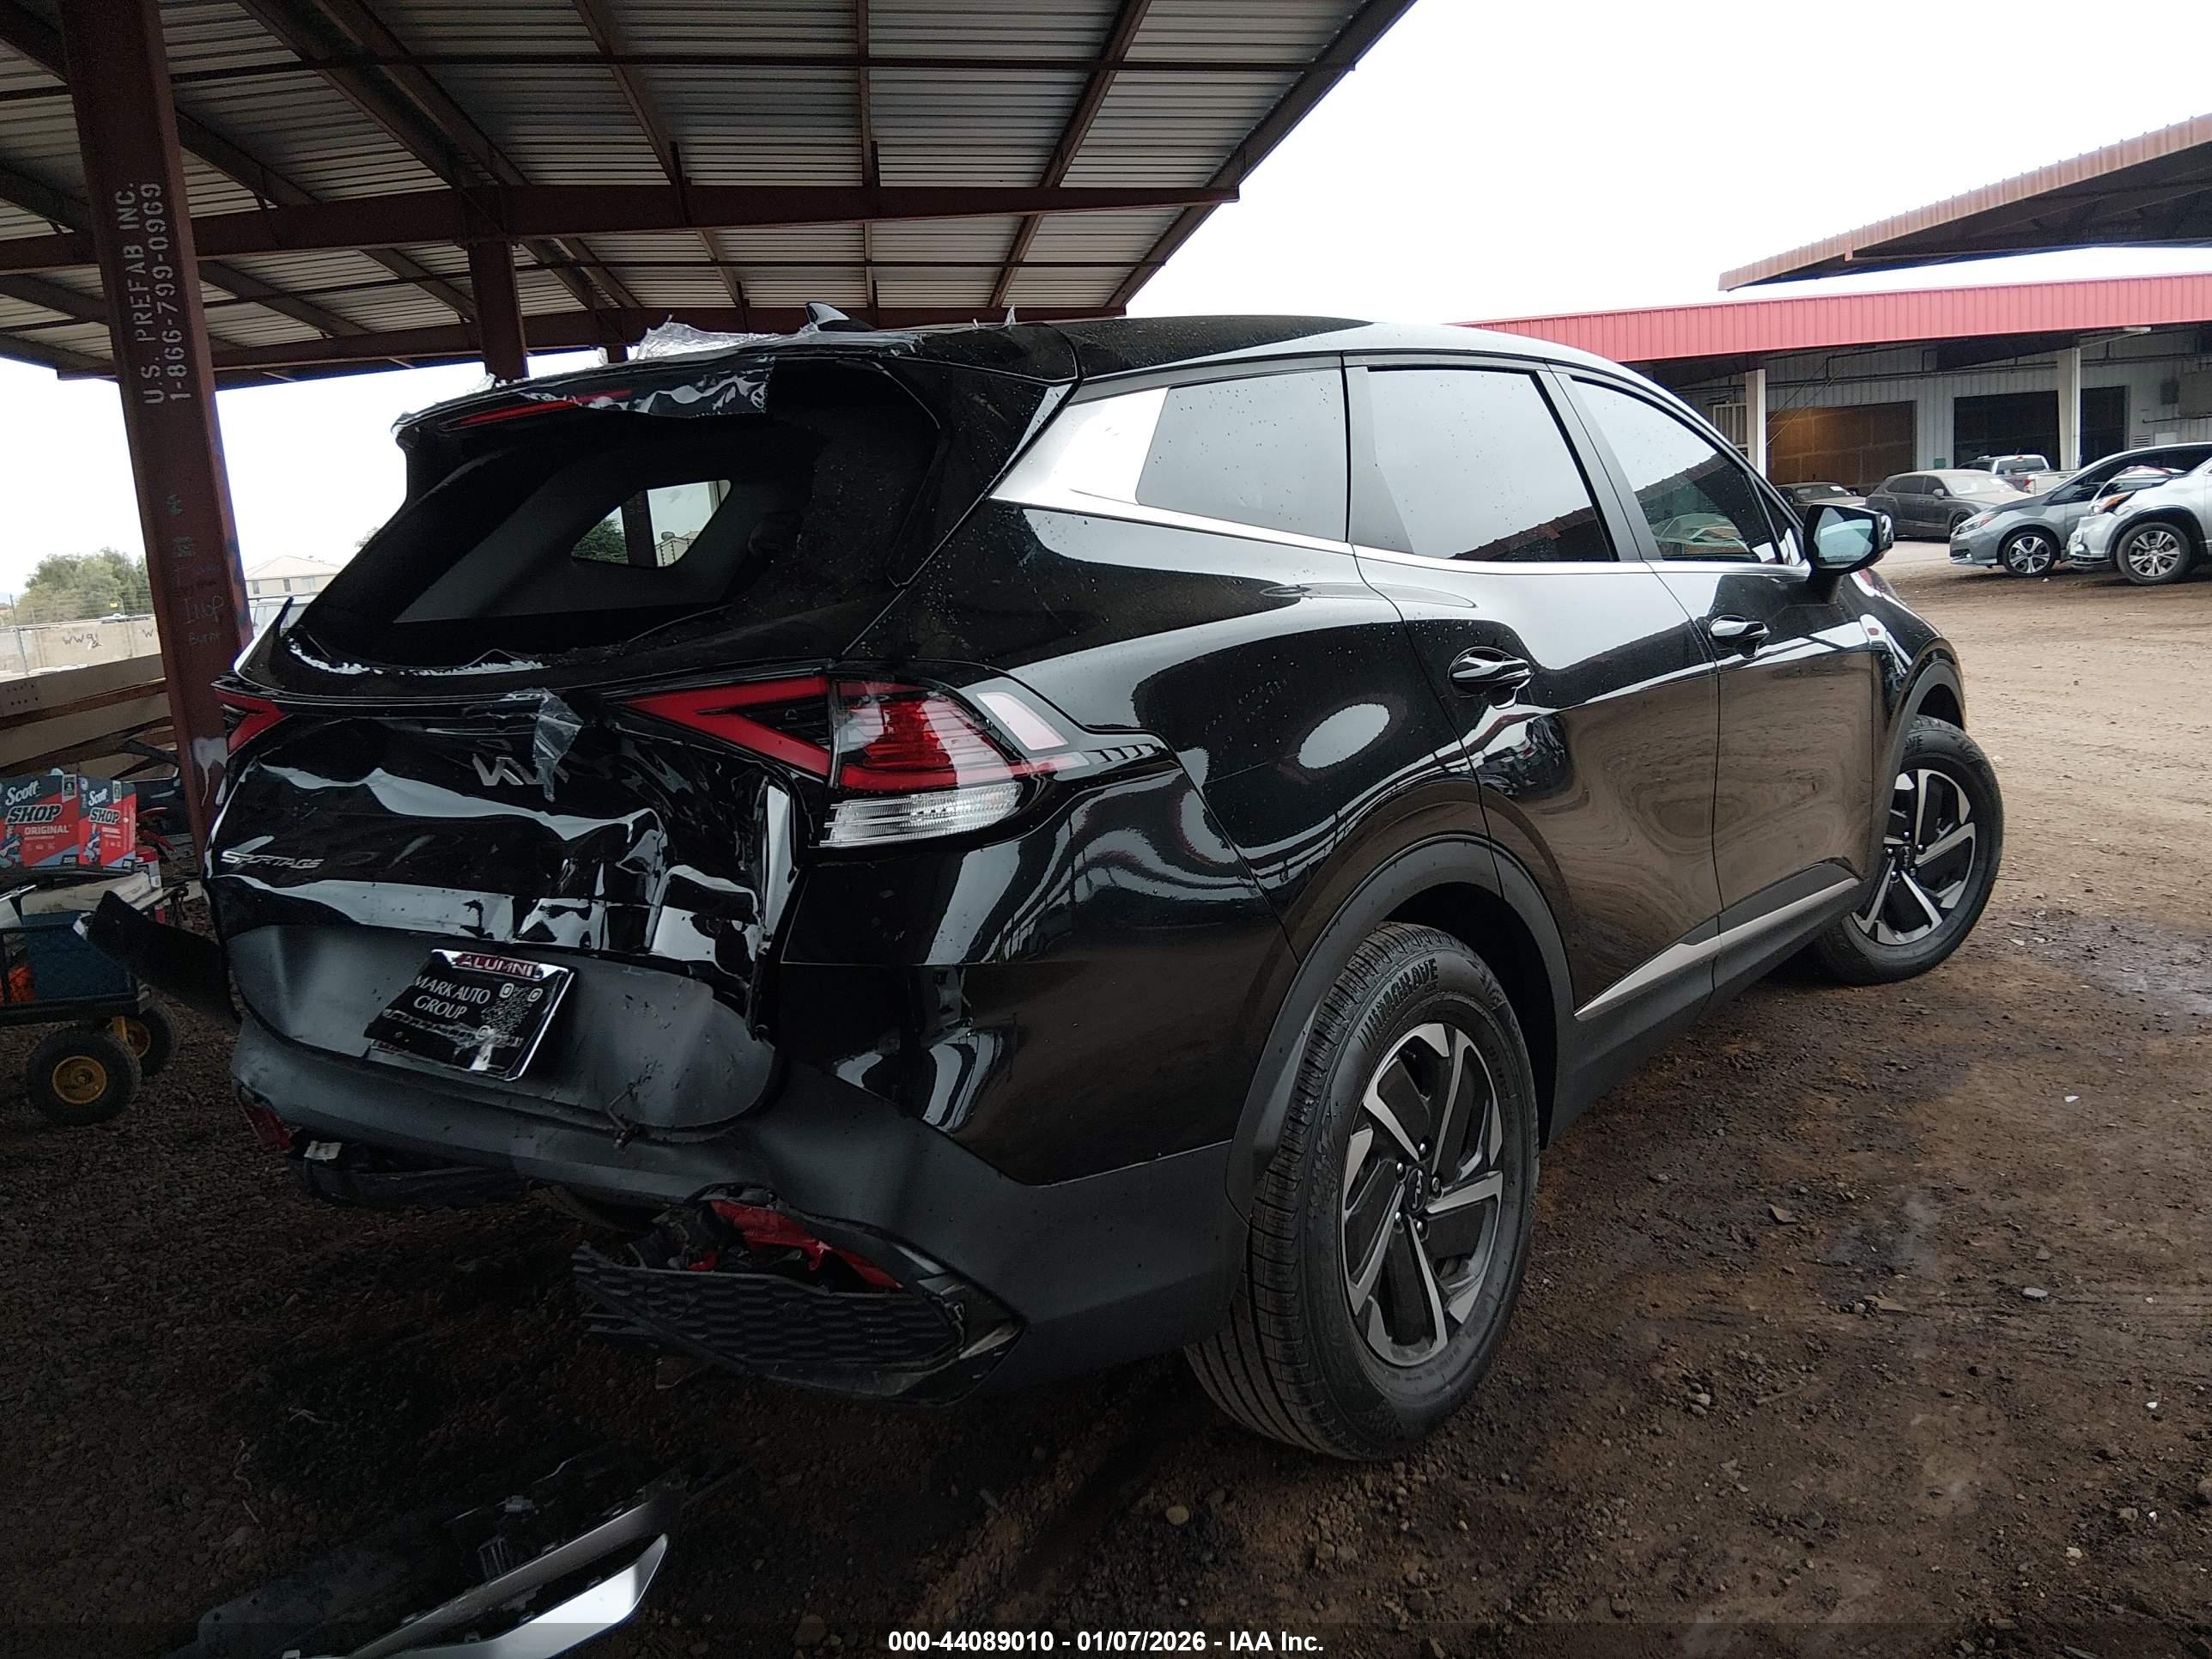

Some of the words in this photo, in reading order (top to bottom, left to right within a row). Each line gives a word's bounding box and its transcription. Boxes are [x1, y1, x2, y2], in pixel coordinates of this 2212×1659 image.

[114, 183, 140, 230] INC.
[123, 244, 157, 342] PREFAB
[140, 356, 166, 404] U.S.
[4, 780, 40, 806] Scott
[88, 787, 108, 806] Scott
[5, 804, 62, 824] SHOP
[88, 806, 120, 824] SHOP
[24, 825, 70, 835] ORIGINAL
[460, 955, 533, 977] ALUMNI
[451, 983, 491, 1006] AUTO
[413, 994, 468, 1020] GROUP
